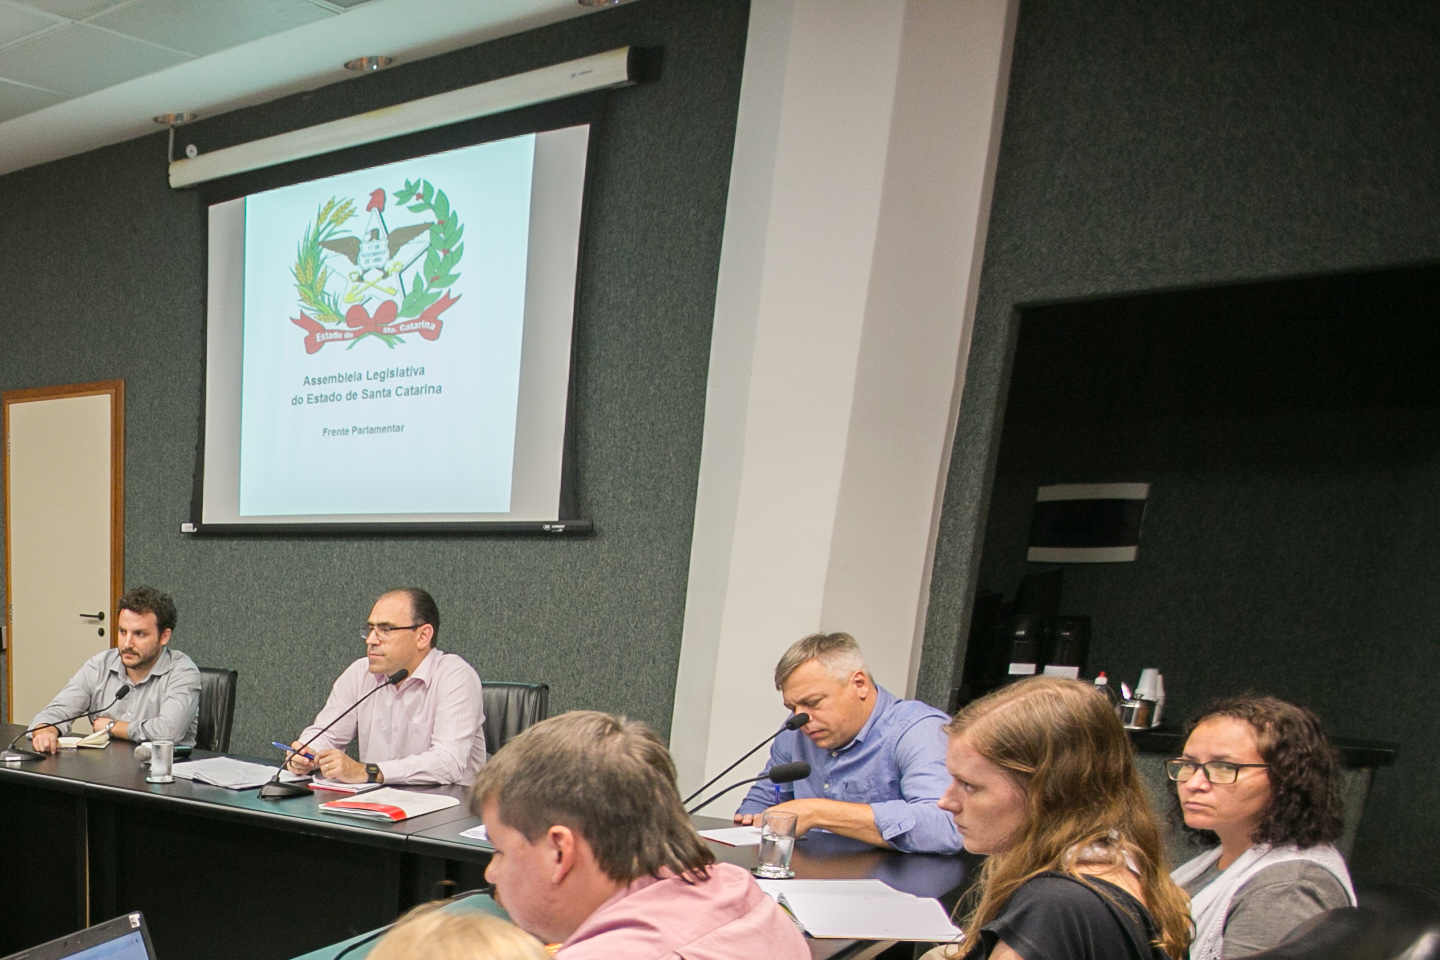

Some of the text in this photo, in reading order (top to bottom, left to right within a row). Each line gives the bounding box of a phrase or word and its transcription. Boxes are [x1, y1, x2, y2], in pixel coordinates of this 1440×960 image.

[315, 331, 342, 342] Estado
[382, 326, 398, 334] Sta.
[399, 320, 436, 332] Catarina
[302, 366, 425, 386] Assembleia Legislativa
[291, 383, 442, 406] do Estado de Santa Catarina
[322, 424, 405, 437] Frente Parlamentar
